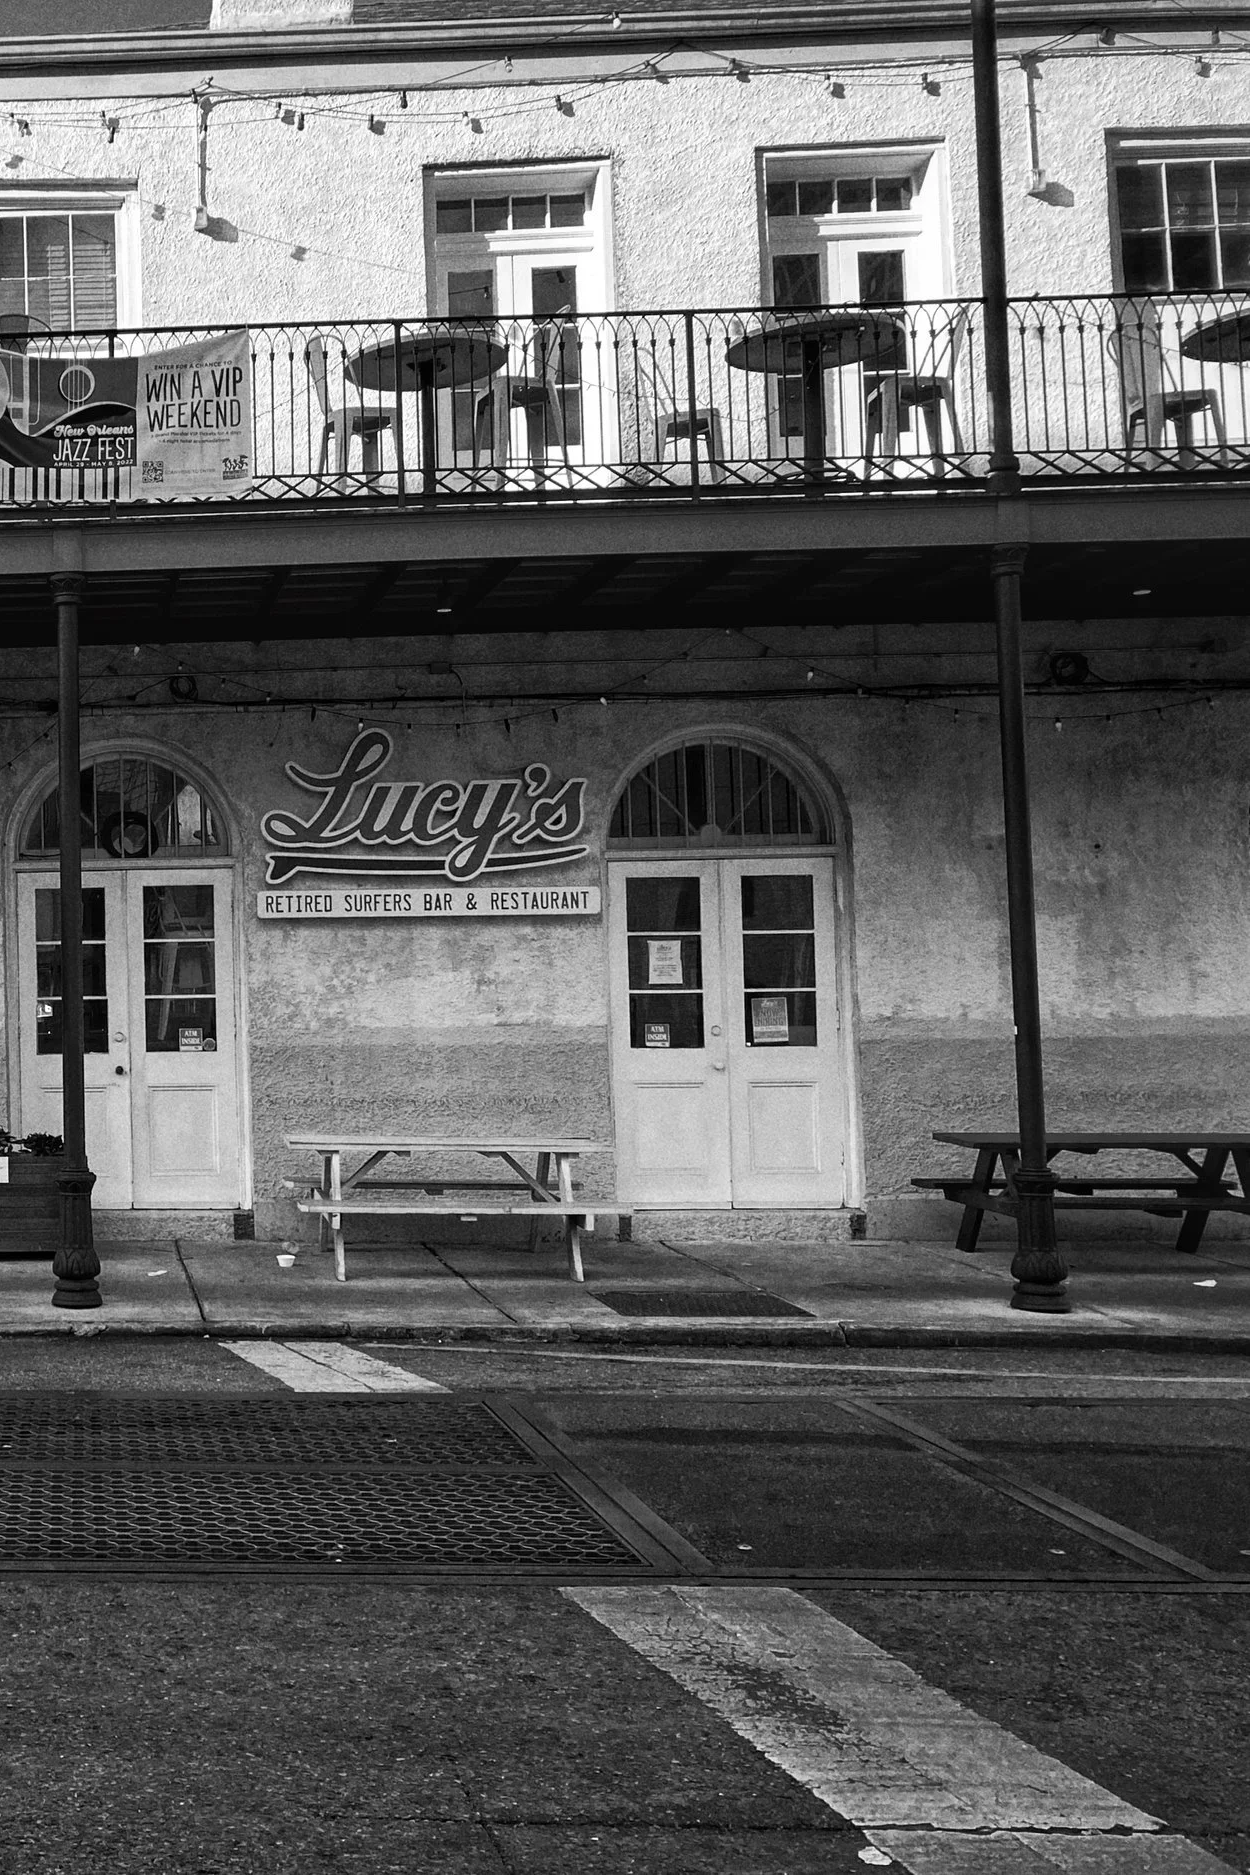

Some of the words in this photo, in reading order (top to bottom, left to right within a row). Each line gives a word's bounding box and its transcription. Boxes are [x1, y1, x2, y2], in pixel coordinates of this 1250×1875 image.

[195, 361, 222, 369] CHANCE
[146, 373, 181, 403] WIN
[191, 370, 203, 399] A
[211, 366, 243, 397] VIP
[146, 399, 241, 432] WEEKEND
[53, 424, 85, 438] New
[86, 424, 134, 437] Orleans
[53, 438, 91, 461] JAZZ
[98, 437, 134, 460] FEST
[261, 728, 588, 882] Lucy's
[266, 895, 332, 913] RETIRED
[344, 894, 412, 912] SURFERS
[424, 892, 452, 911] BAR
[466, 892, 477, 910] &
[491, 890, 589, 909] RESTAURANT
